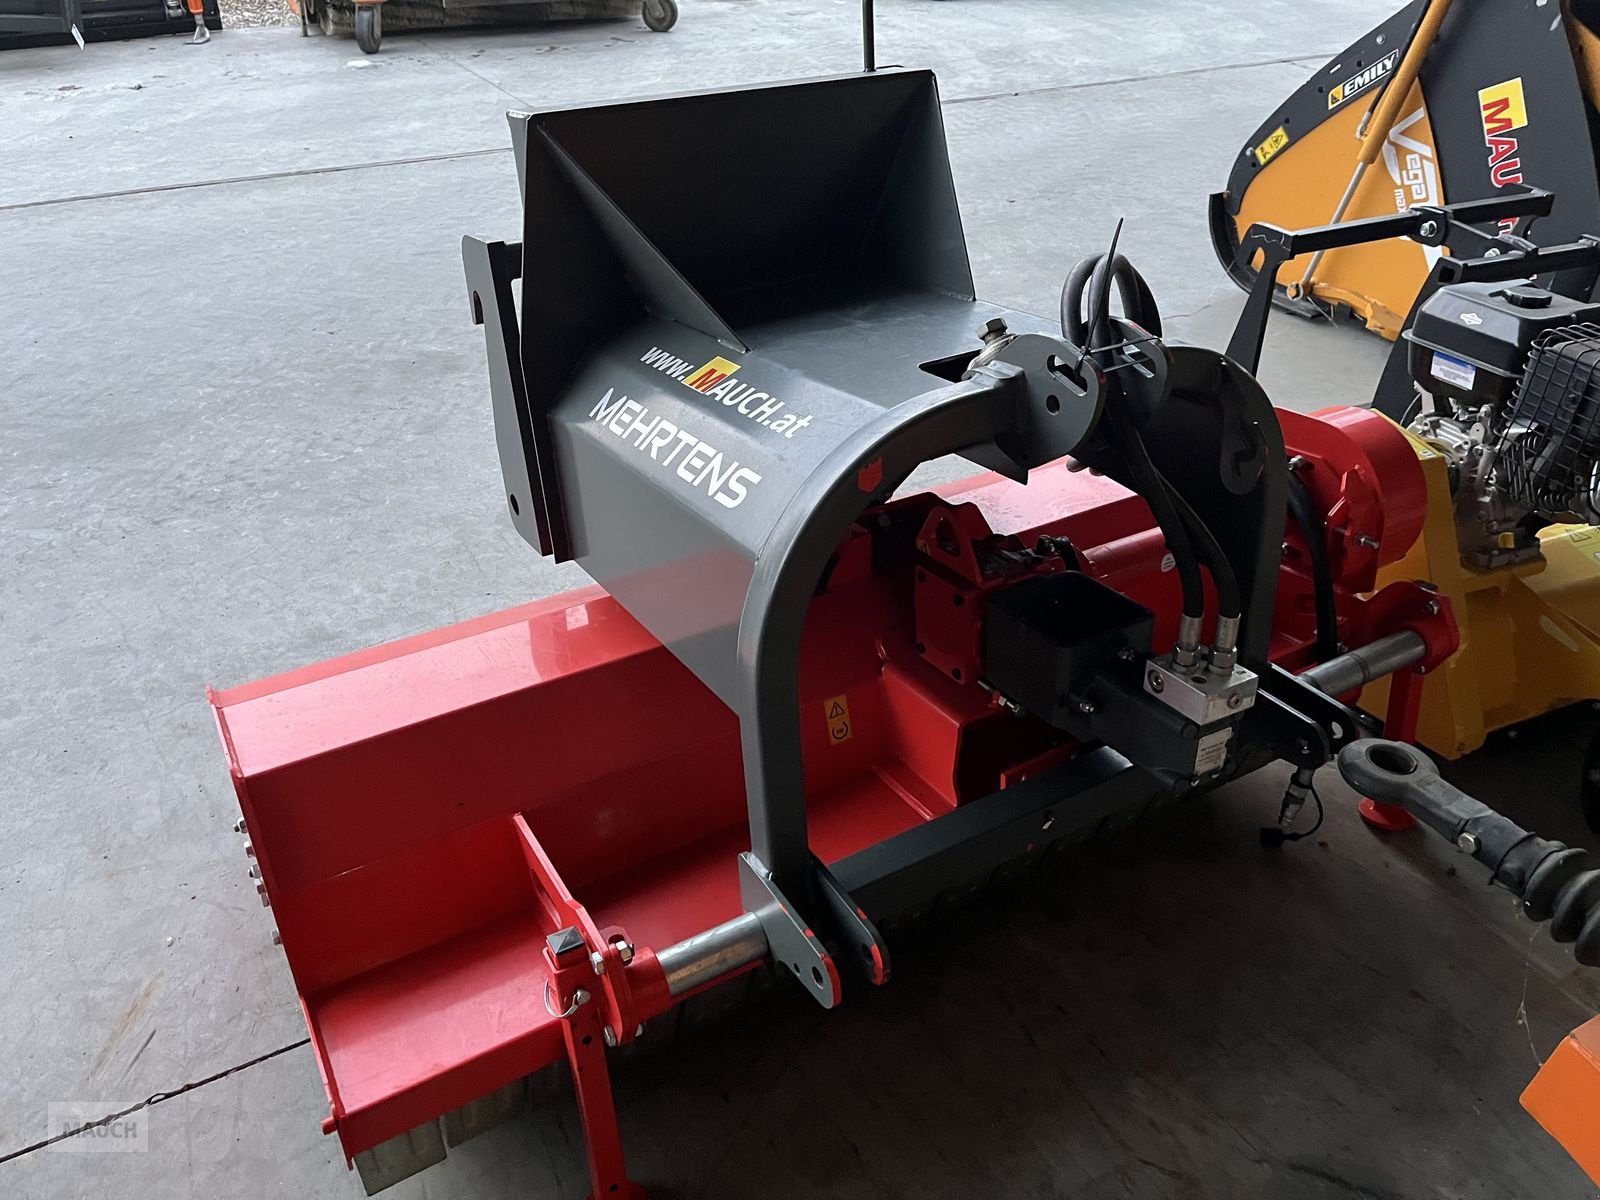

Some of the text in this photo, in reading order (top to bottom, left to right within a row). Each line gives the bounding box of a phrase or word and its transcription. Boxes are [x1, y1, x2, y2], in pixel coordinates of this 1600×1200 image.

[1343, 54, 1395, 97] EMILY
[640, 346, 814, 439] www.MAUCH.at
[588, 387, 763, 509] MEHRTENS
